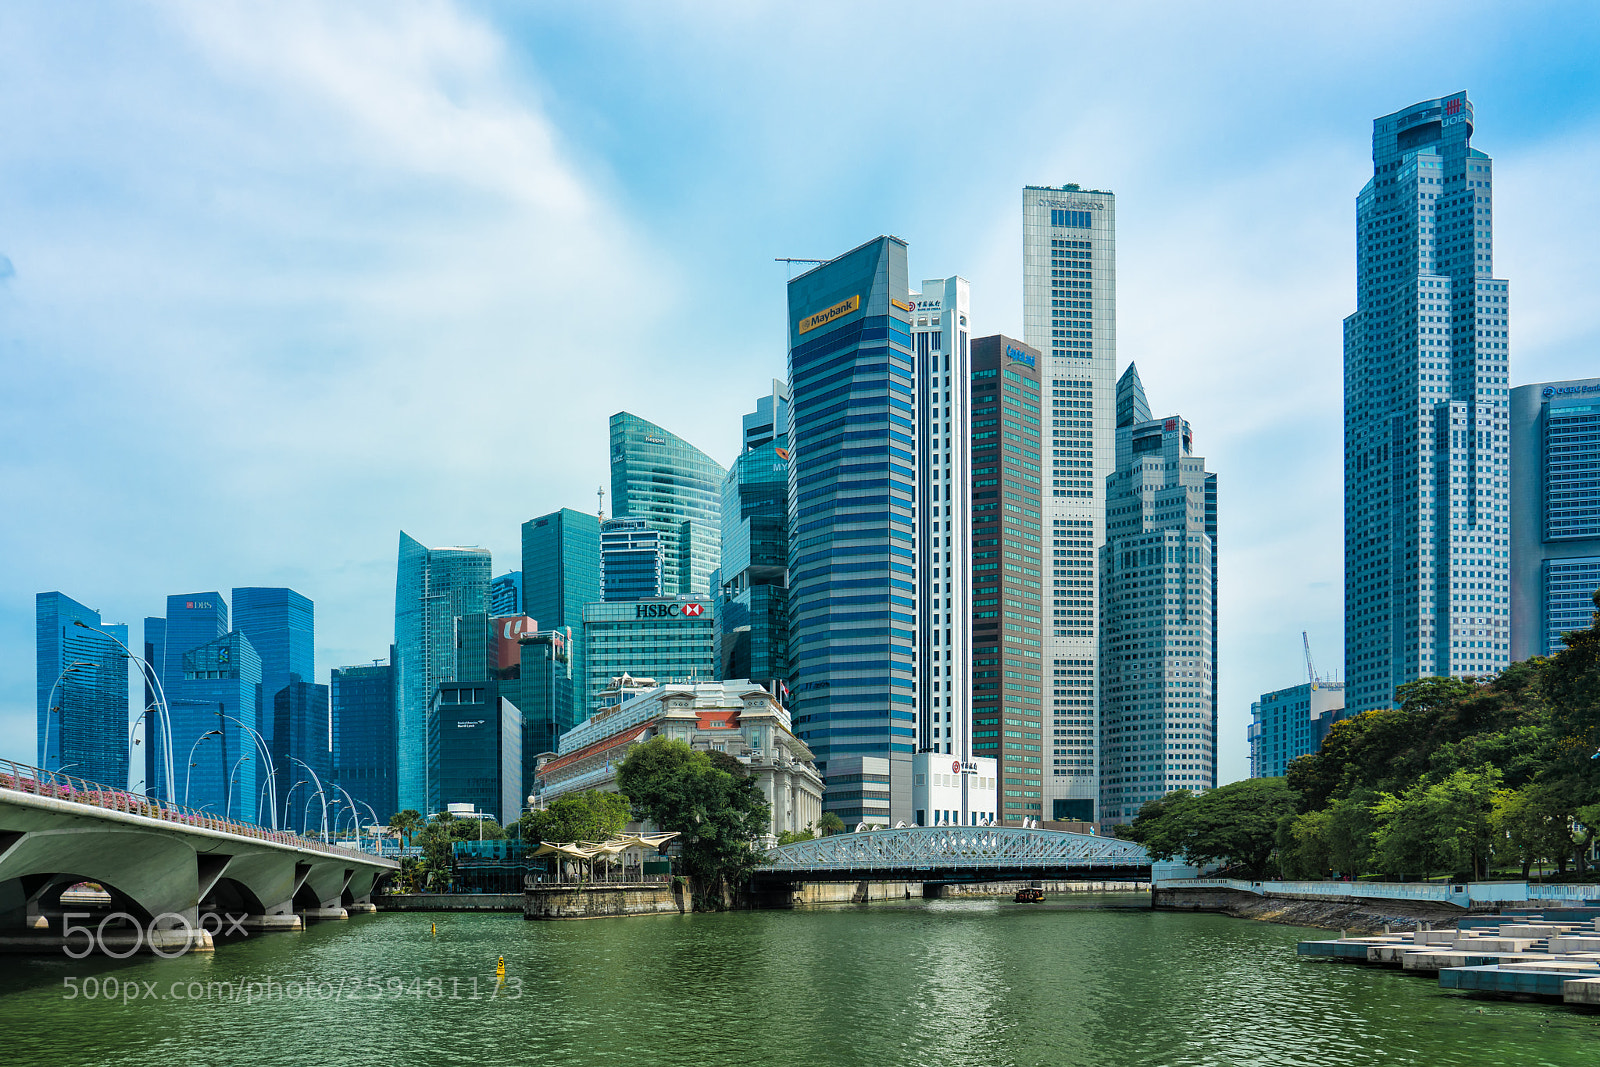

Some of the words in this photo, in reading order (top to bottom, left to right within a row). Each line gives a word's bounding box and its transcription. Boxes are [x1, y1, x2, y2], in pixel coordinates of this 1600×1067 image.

[1441, 114, 1466, 128] UOB
[811, 301, 853, 327] Maybank
[1162, 431, 1179, 440] UOB
[194, 601, 212, 609] DBS
[636, 603, 679, 617] HSBC
[498, 959, 504, 967] 5
